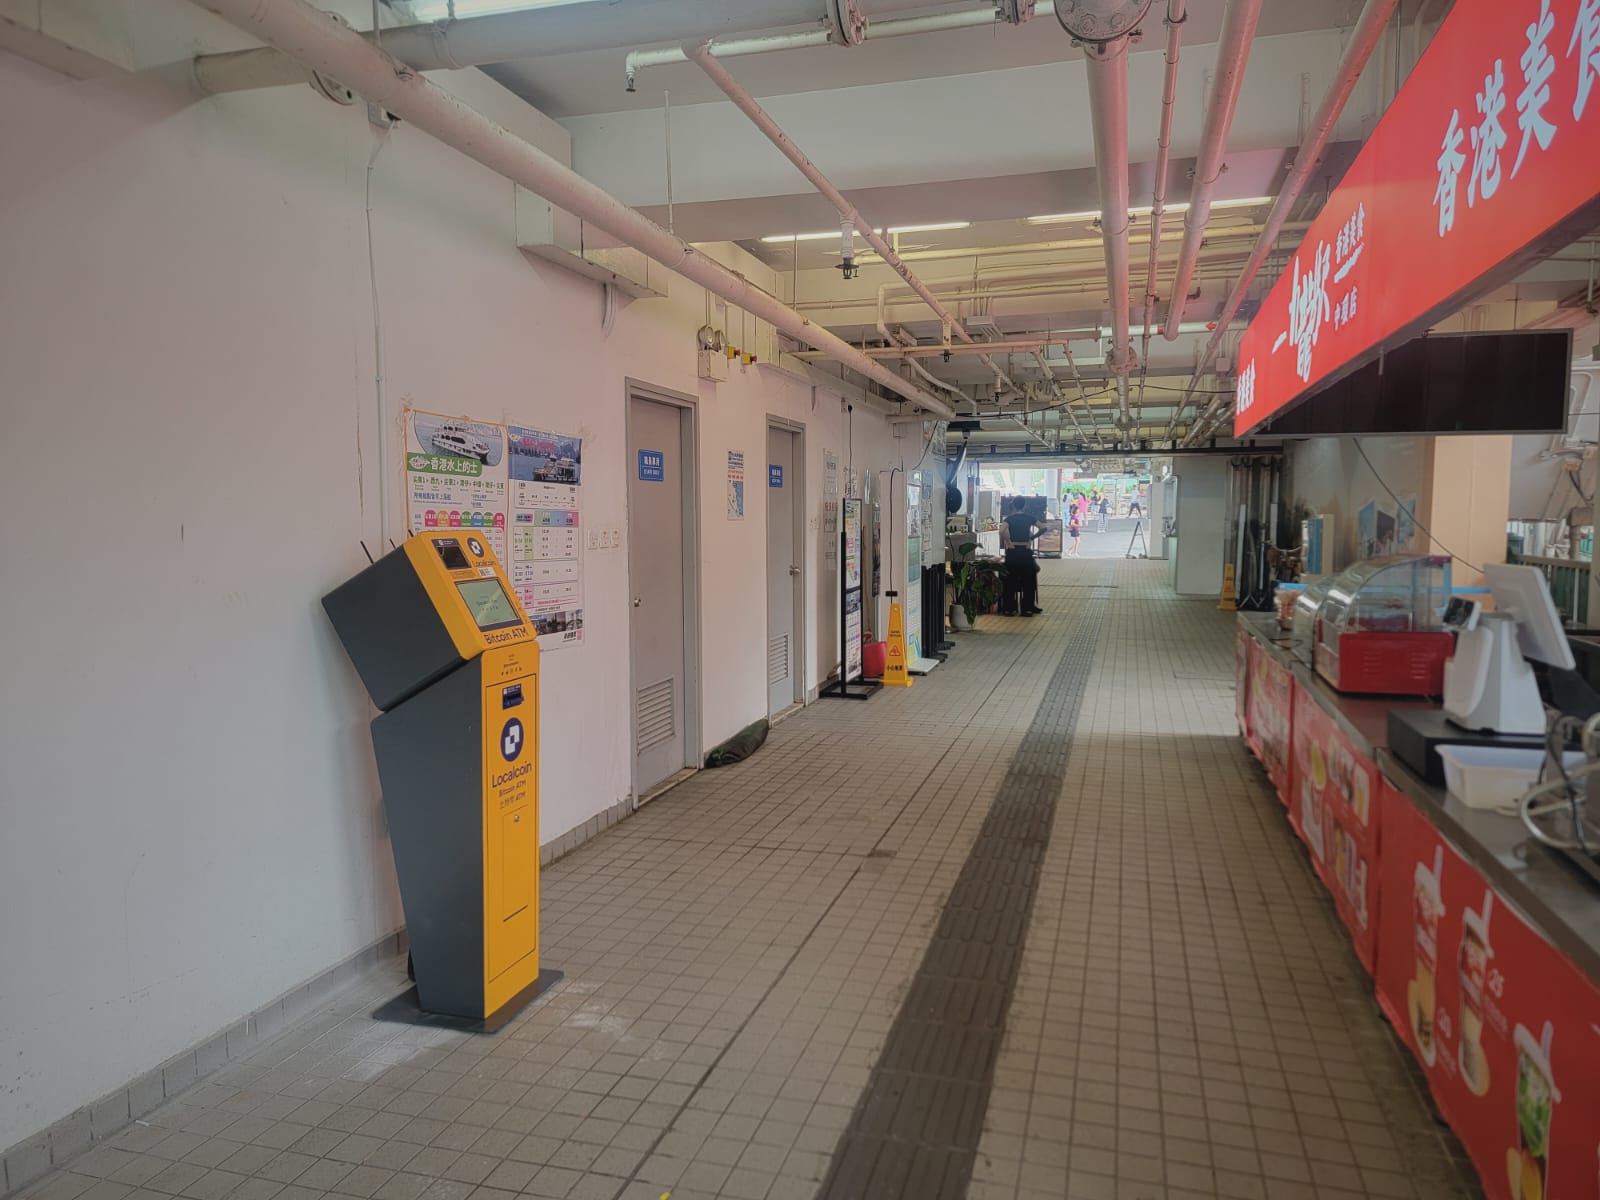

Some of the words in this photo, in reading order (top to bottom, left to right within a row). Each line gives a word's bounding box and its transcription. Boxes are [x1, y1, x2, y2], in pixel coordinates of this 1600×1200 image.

[1335, 202, 1366, 265] 香港美食
[430, 457, 478, 474] 香港水上的士
[484, 632, 512, 645] Bitcoin
[512, 626, 530, 639] ATM
[491, 760, 532, 789] Localcoin
